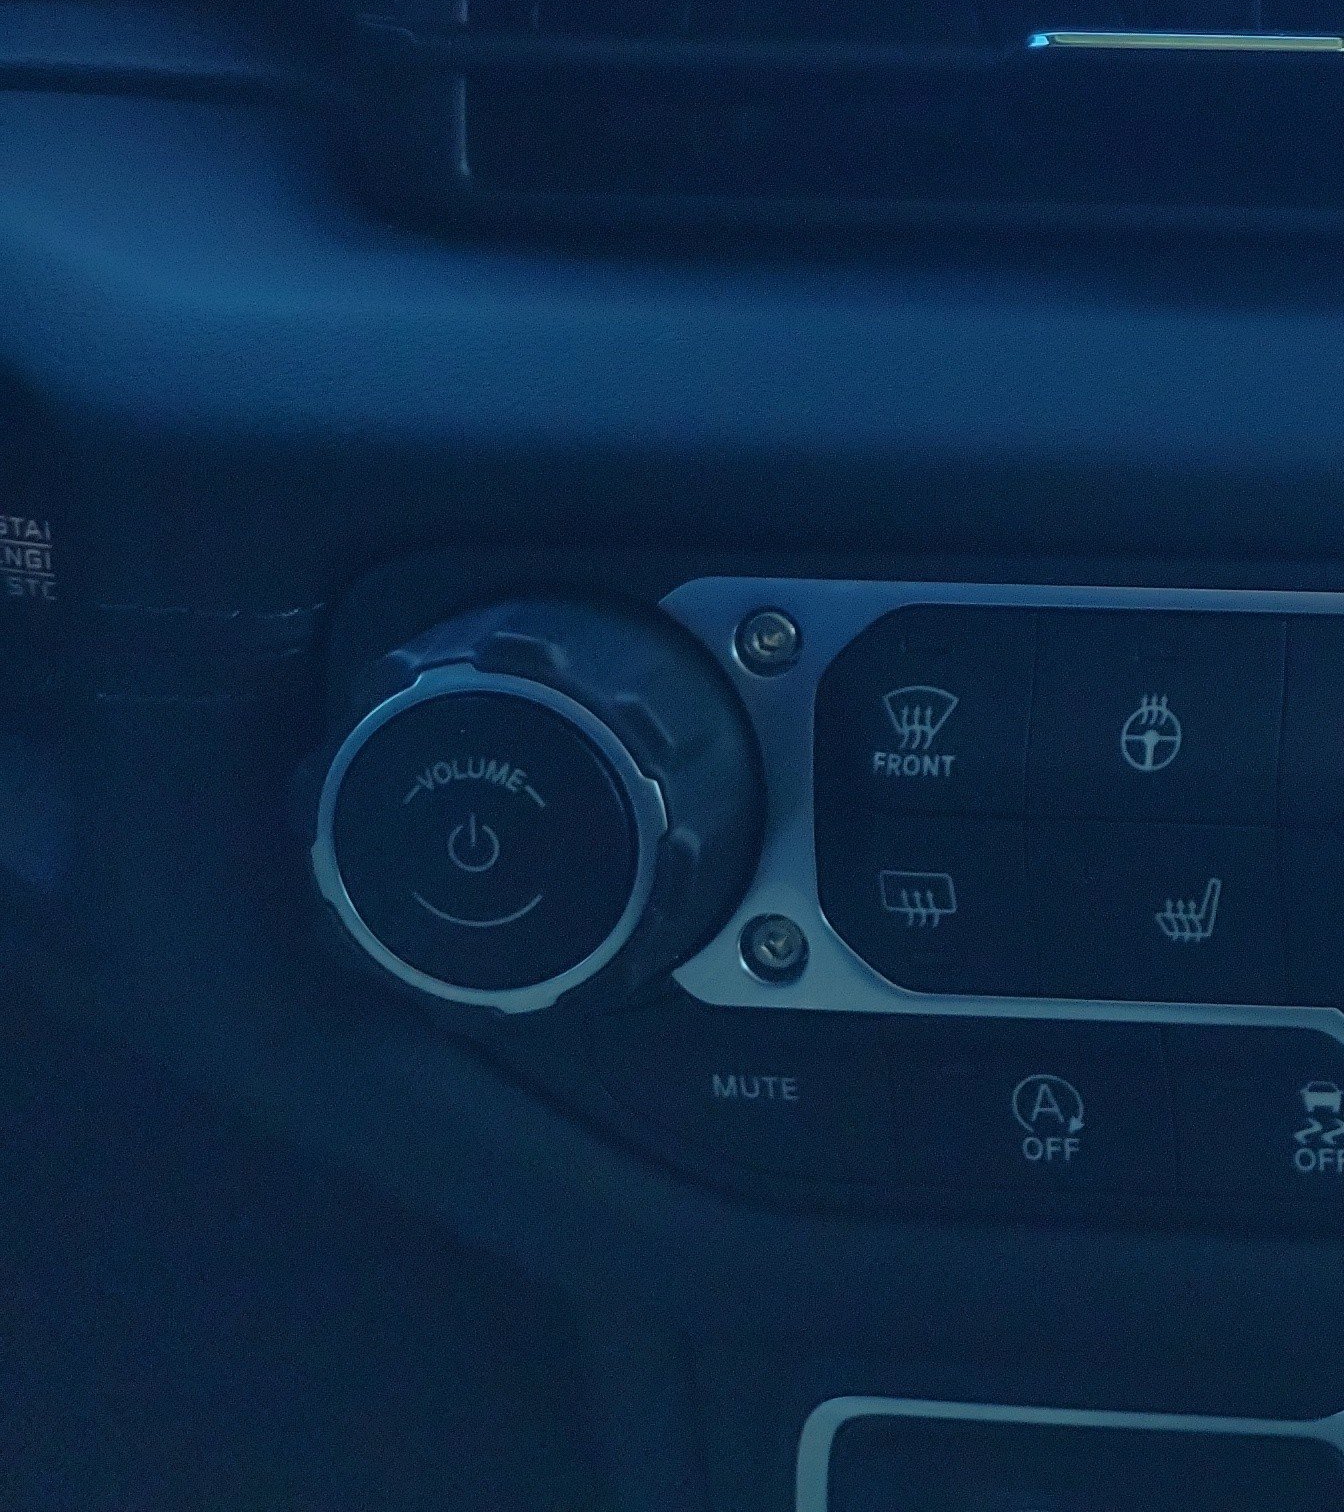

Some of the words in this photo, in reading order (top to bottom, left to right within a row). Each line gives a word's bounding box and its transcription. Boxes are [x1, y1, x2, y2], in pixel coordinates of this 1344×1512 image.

[416, 757, 527, 794] VOLUME
[873, 750, 957, 779] FRONT
[711, 1073, 799, 1102] MUTE
[1031, 1082, 1065, 1123] A
[1022, 1135, 1081, 1162] OFF
